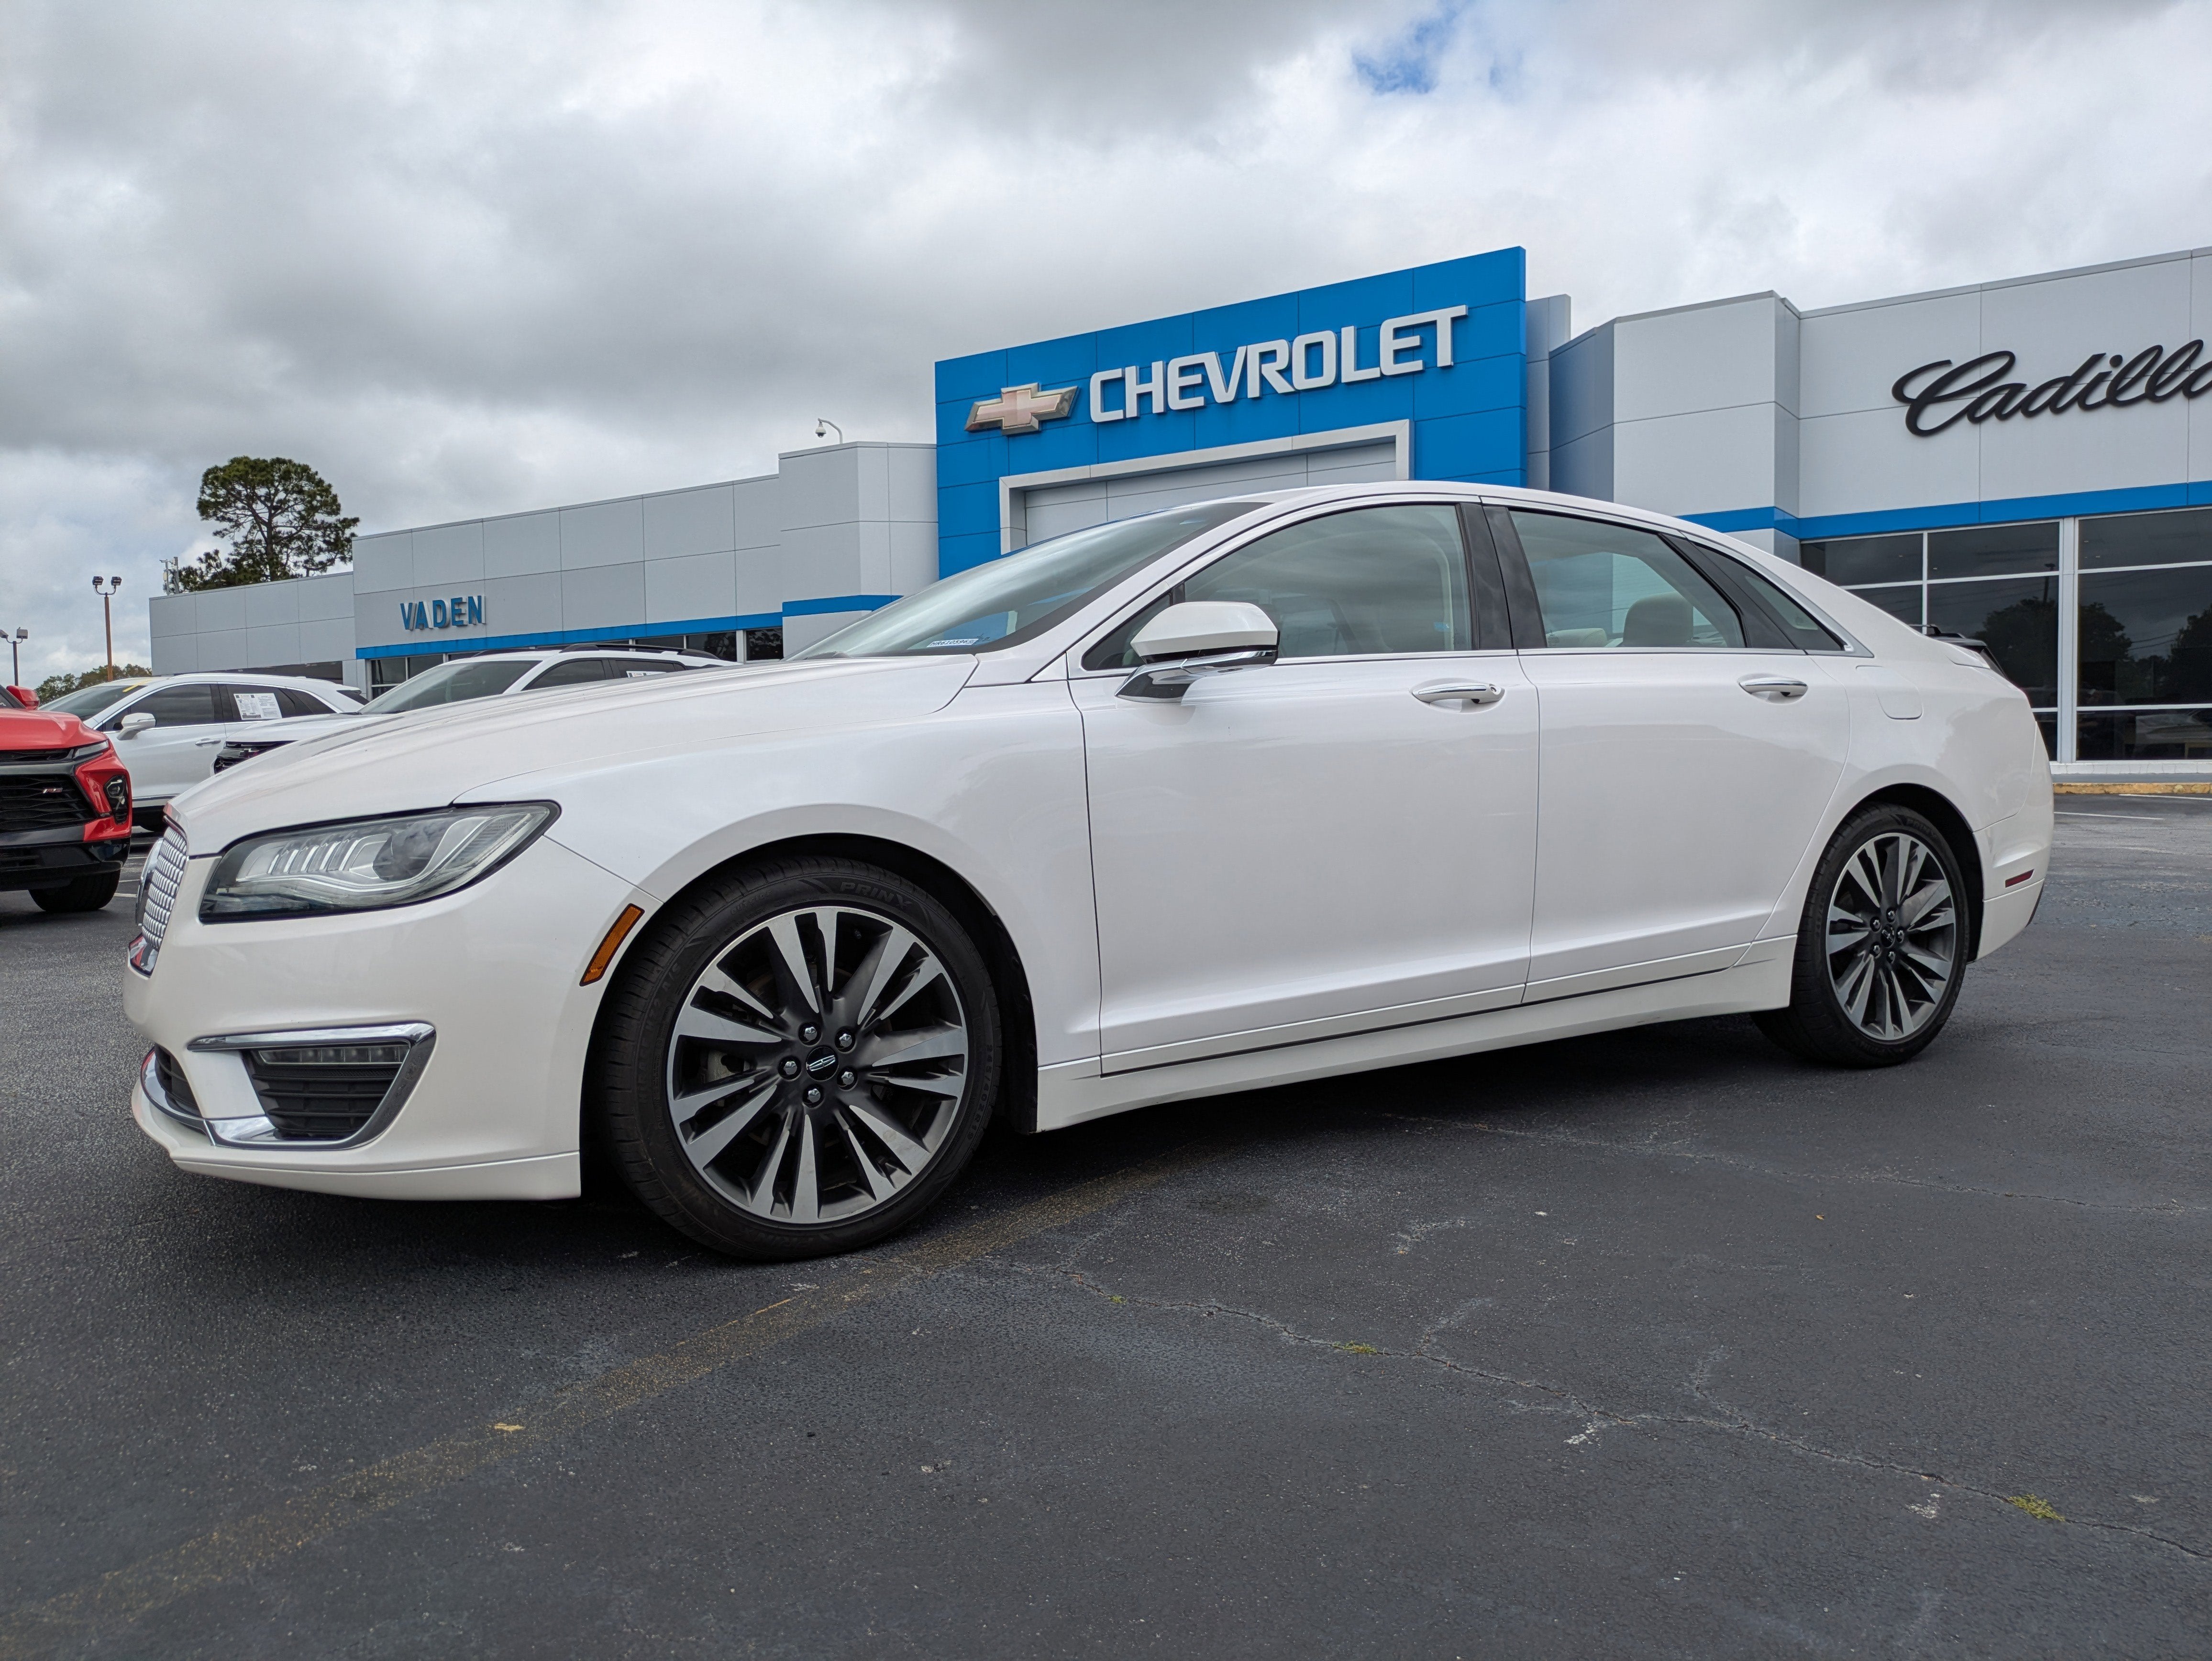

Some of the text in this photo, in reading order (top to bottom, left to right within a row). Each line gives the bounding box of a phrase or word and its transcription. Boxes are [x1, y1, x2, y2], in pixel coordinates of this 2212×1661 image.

[1089, 304, 1468, 423] CHEVROLET
[400, 595, 485, 631] VADEN
[840, 882, 913, 910] PRINX
